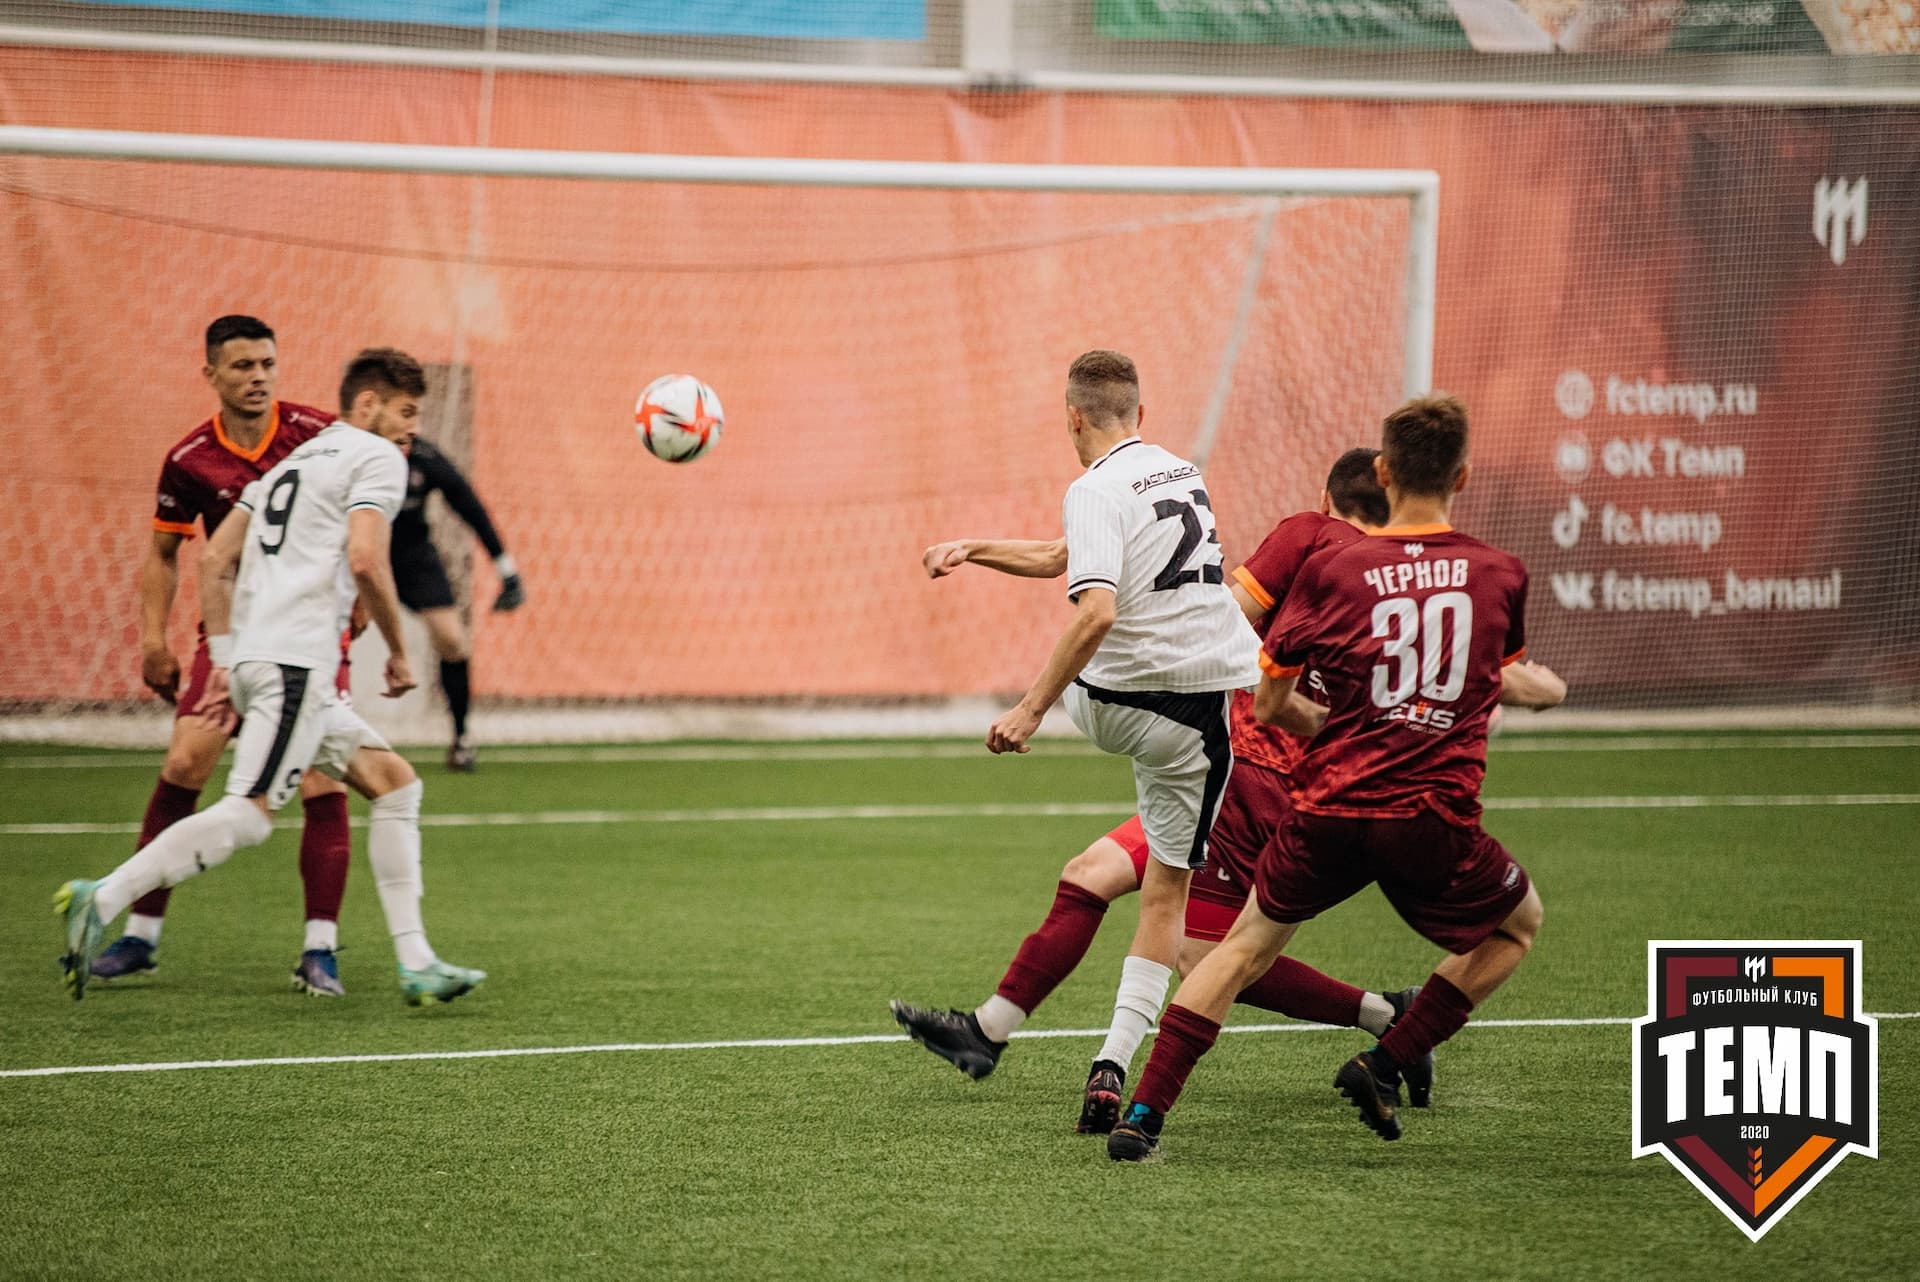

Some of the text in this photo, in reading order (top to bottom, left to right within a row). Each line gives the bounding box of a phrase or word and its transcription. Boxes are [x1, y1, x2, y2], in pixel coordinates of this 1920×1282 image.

[1606, 372, 1758, 425] fctemp.ru
[1659, 436, 1746, 479] Темп
[259, 468, 301, 555] 9
[1602, 504, 1722, 552] fc.temp
[1363, 559, 1469, 596] ЧЕРНОВ
[1602, 567, 1842, 619] fctemp_barnaul
[1371, 591, 1473, 709] 30
